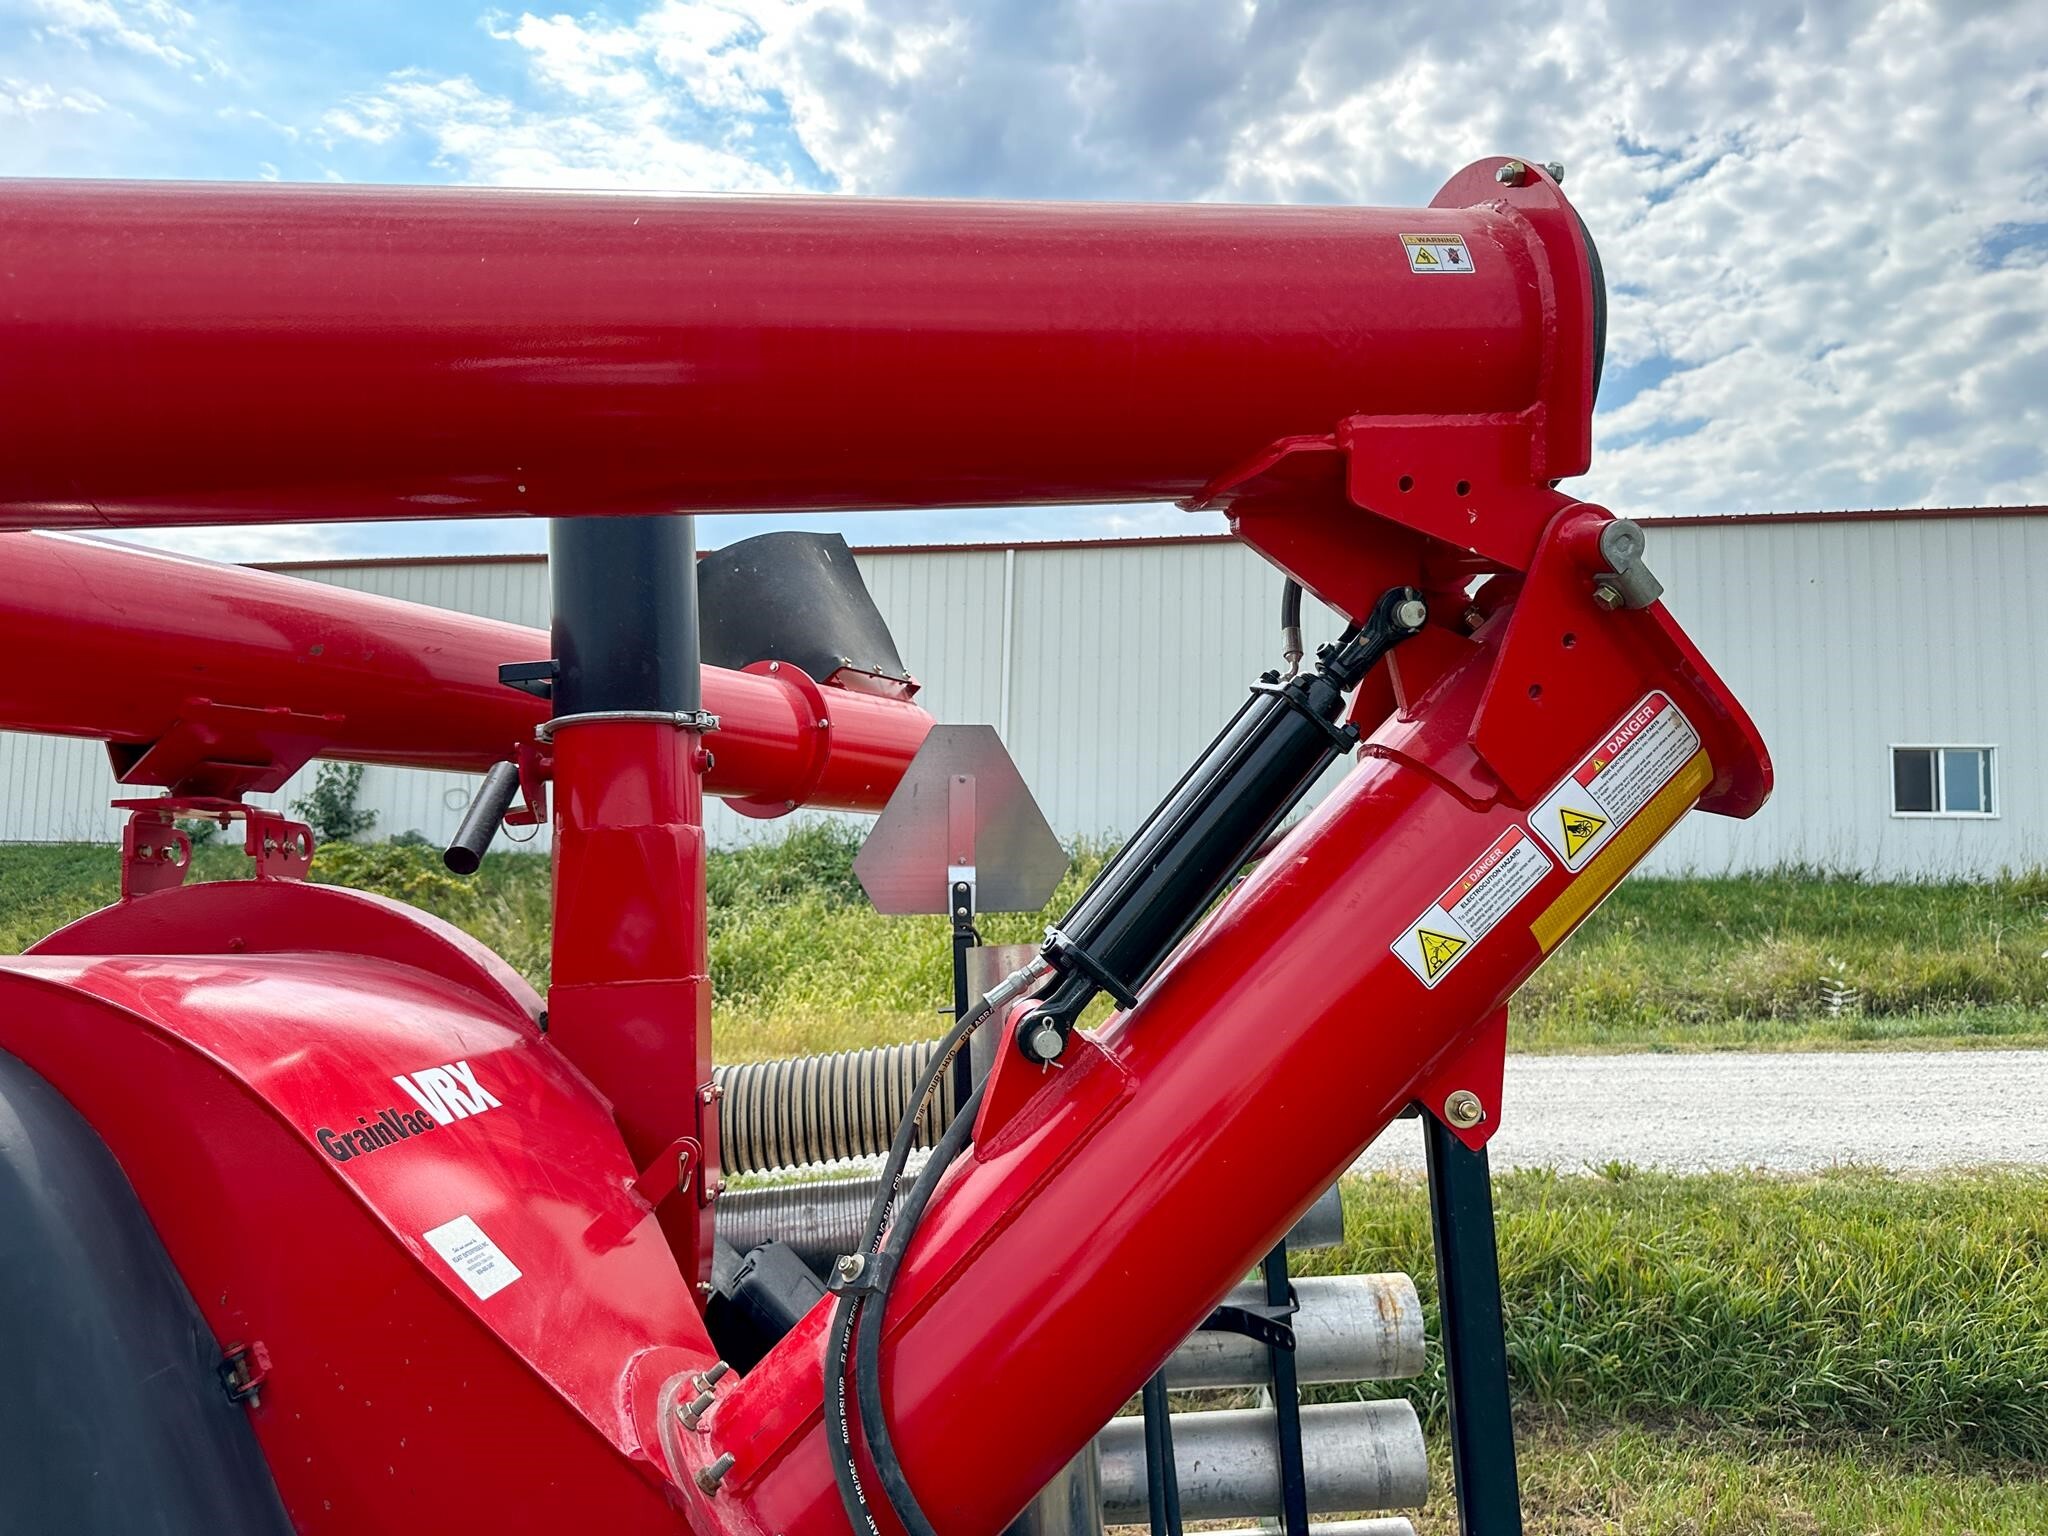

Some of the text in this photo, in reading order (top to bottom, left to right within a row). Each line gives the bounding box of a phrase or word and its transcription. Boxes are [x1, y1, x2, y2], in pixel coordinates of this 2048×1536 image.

[1600, 768, 1611, 779] HIGH
[1645, 719, 1659, 734] PARTS
[1605, 705, 1655, 755] DANGER
[1459, 847, 1521, 909] ELECTROCUTION HAZARD
[1468, 847, 1504, 882] DANGER
[928, 1049, 956, 1094] DURA-HYD
[316, 1060, 504, 1162] GrainVac VRX
[872, 1235, 882, 1254] SHA
[866, 1514, 881, 1536] ANT
